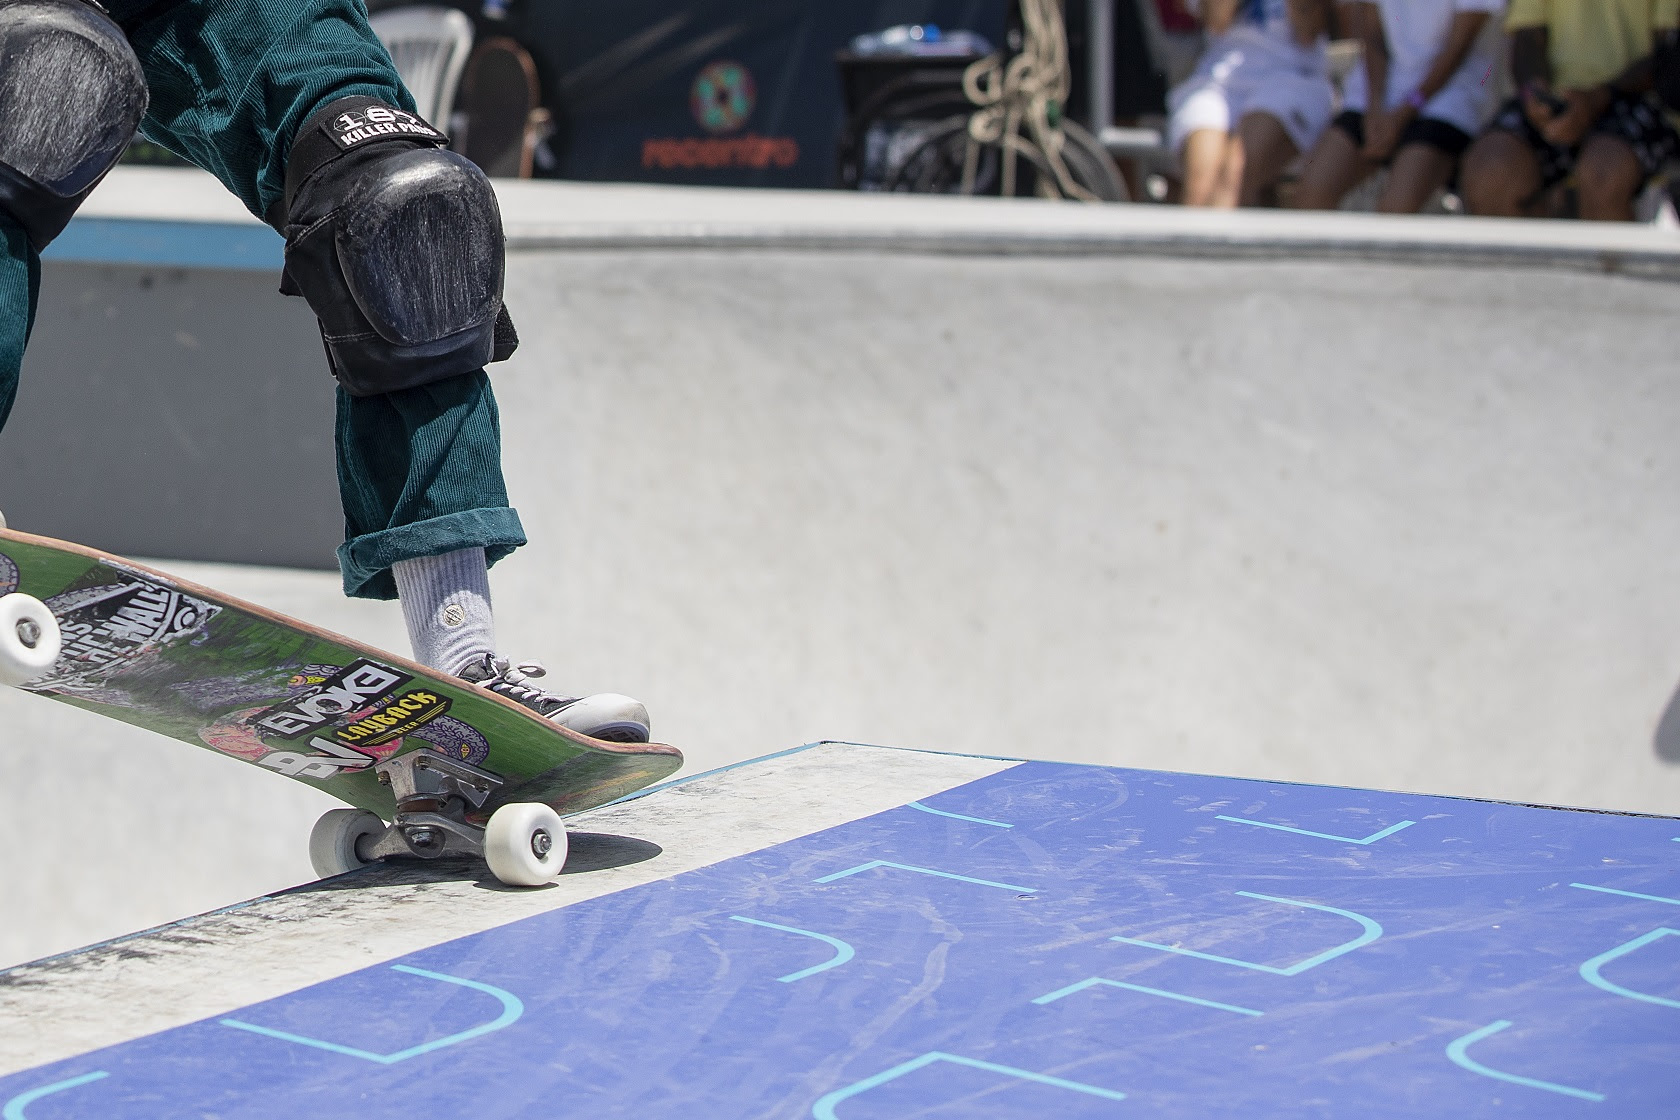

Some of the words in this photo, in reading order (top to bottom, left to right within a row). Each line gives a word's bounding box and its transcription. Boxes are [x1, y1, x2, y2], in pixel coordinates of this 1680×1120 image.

[341, 122, 400, 146] KILLER
[397, 122, 438, 137] PADS
[259, 664, 401, 735] EVOKE
[337, 691, 438, 741] LAYBACK
